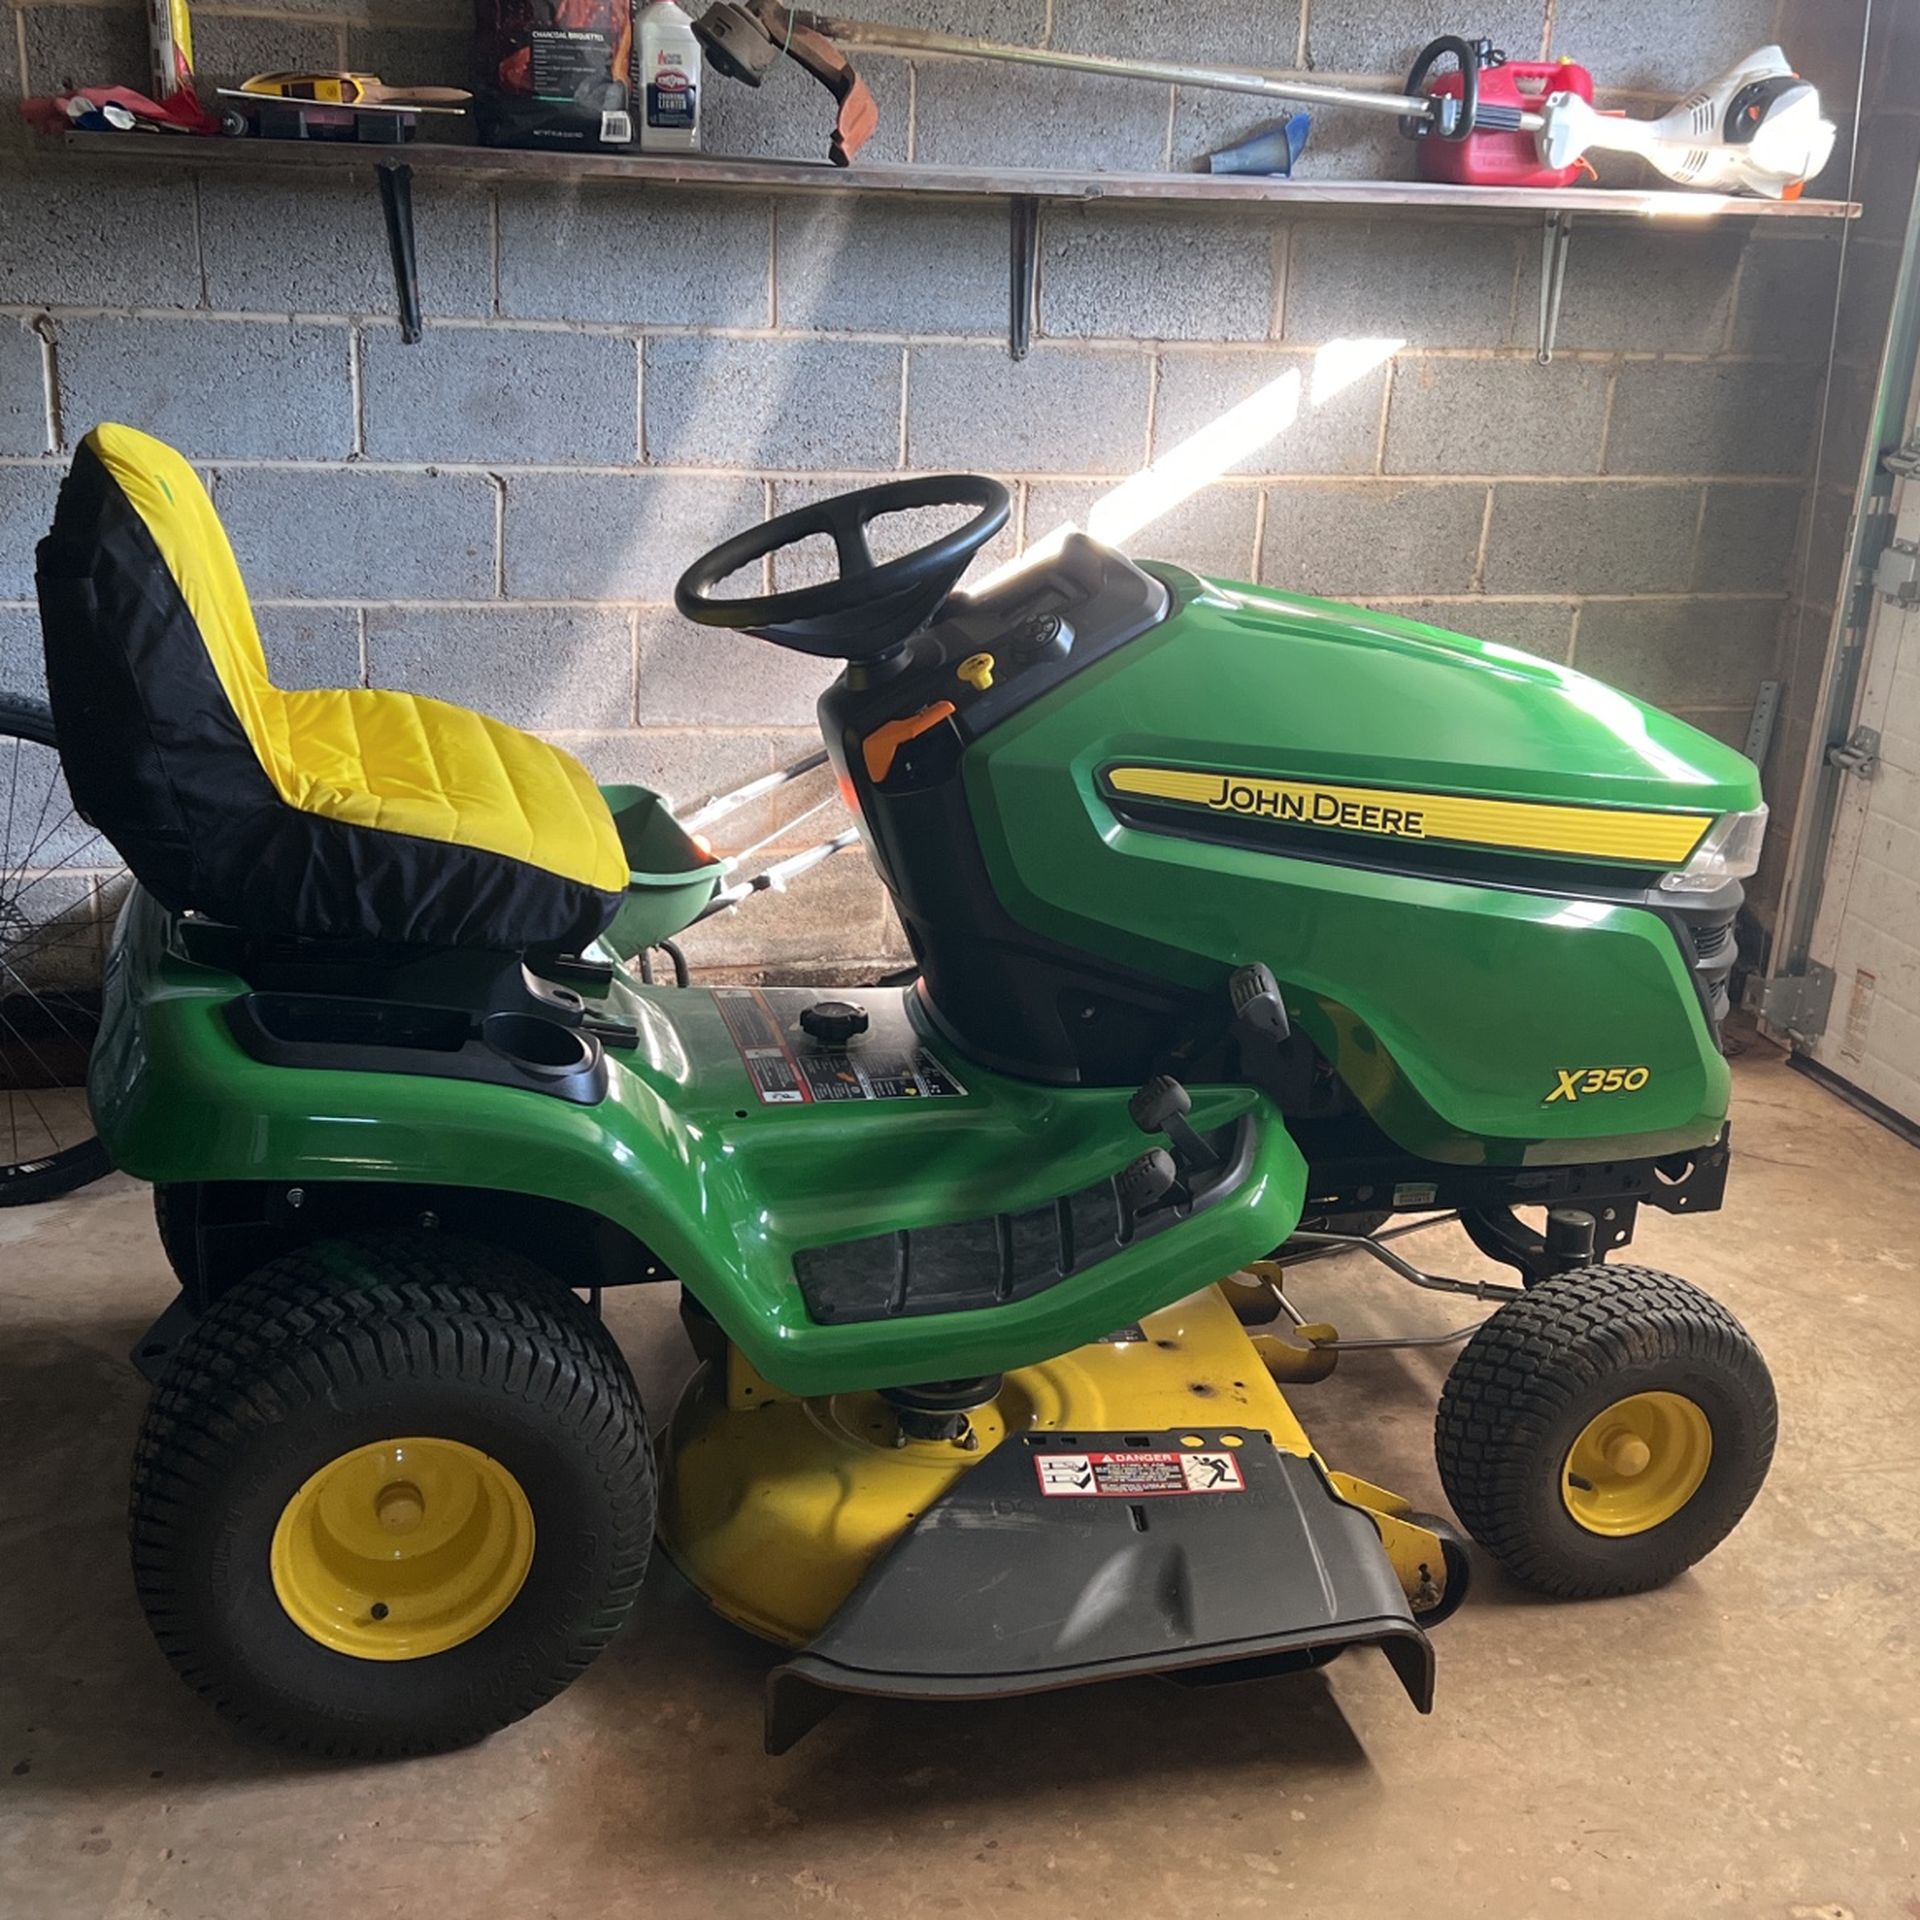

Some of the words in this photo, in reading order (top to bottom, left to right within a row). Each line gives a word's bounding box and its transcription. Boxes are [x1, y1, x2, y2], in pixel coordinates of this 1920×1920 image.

[1209, 778, 1304, 819] JOHN
[1312, 793, 1424, 834] DEERE
[1544, 1066, 1650, 1102] X350
[1115, 1453, 1172, 1462] DANGER
